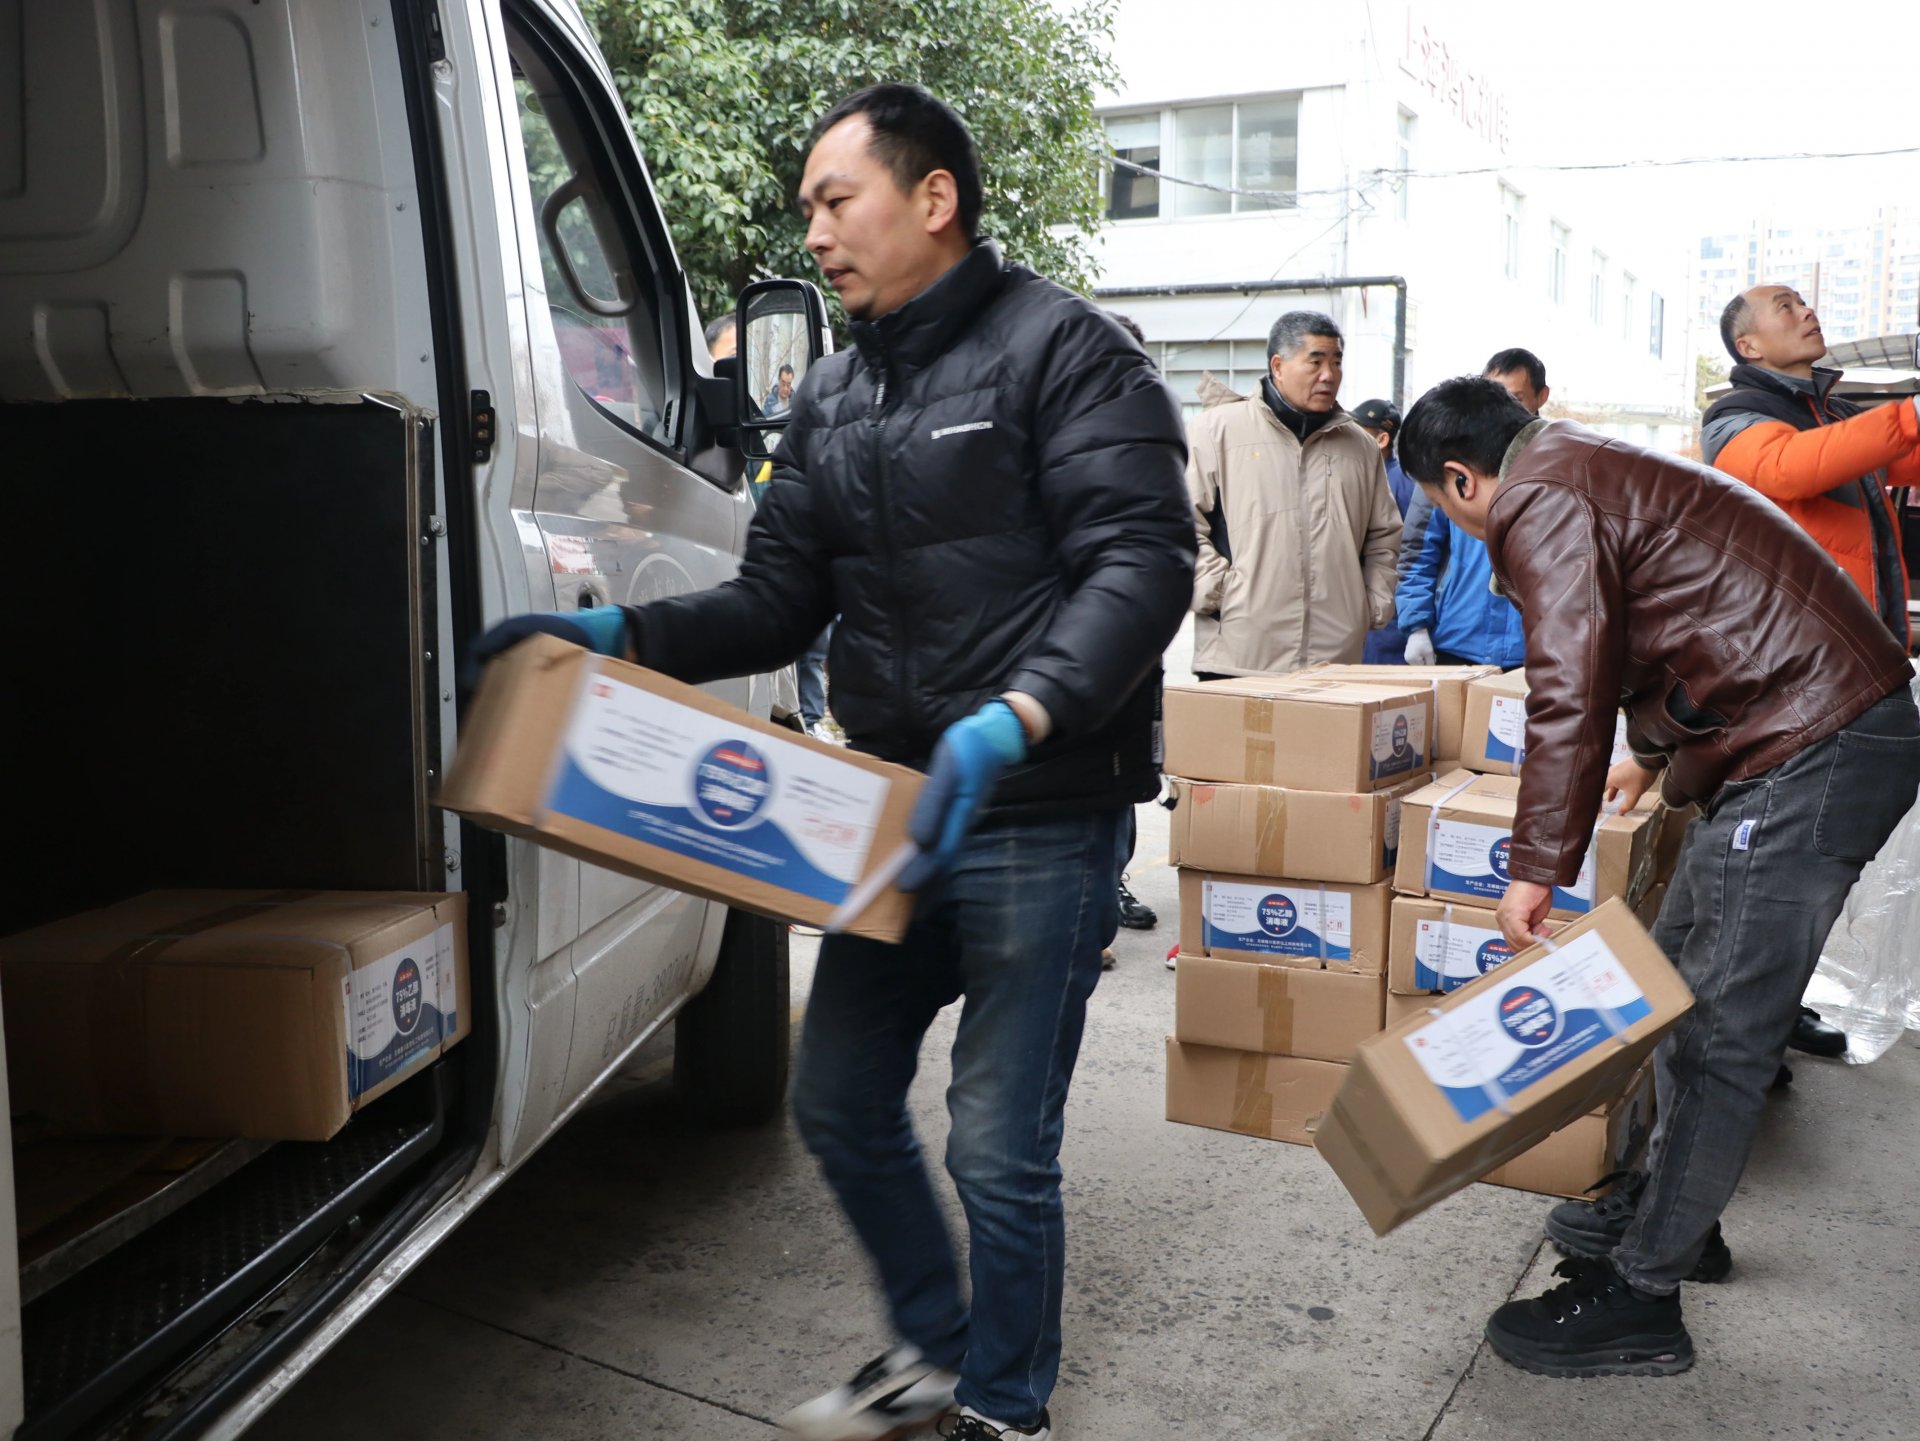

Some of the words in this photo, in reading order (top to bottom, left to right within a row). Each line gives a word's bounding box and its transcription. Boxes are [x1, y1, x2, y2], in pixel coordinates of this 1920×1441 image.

[1262, 908, 1293, 918] 75%乙醇
[1265, 917, 1289, 927] 消毒液
[395, 980, 419, 1004] 75%乙醇
[399, 998, 417, 1019] 消毒液
